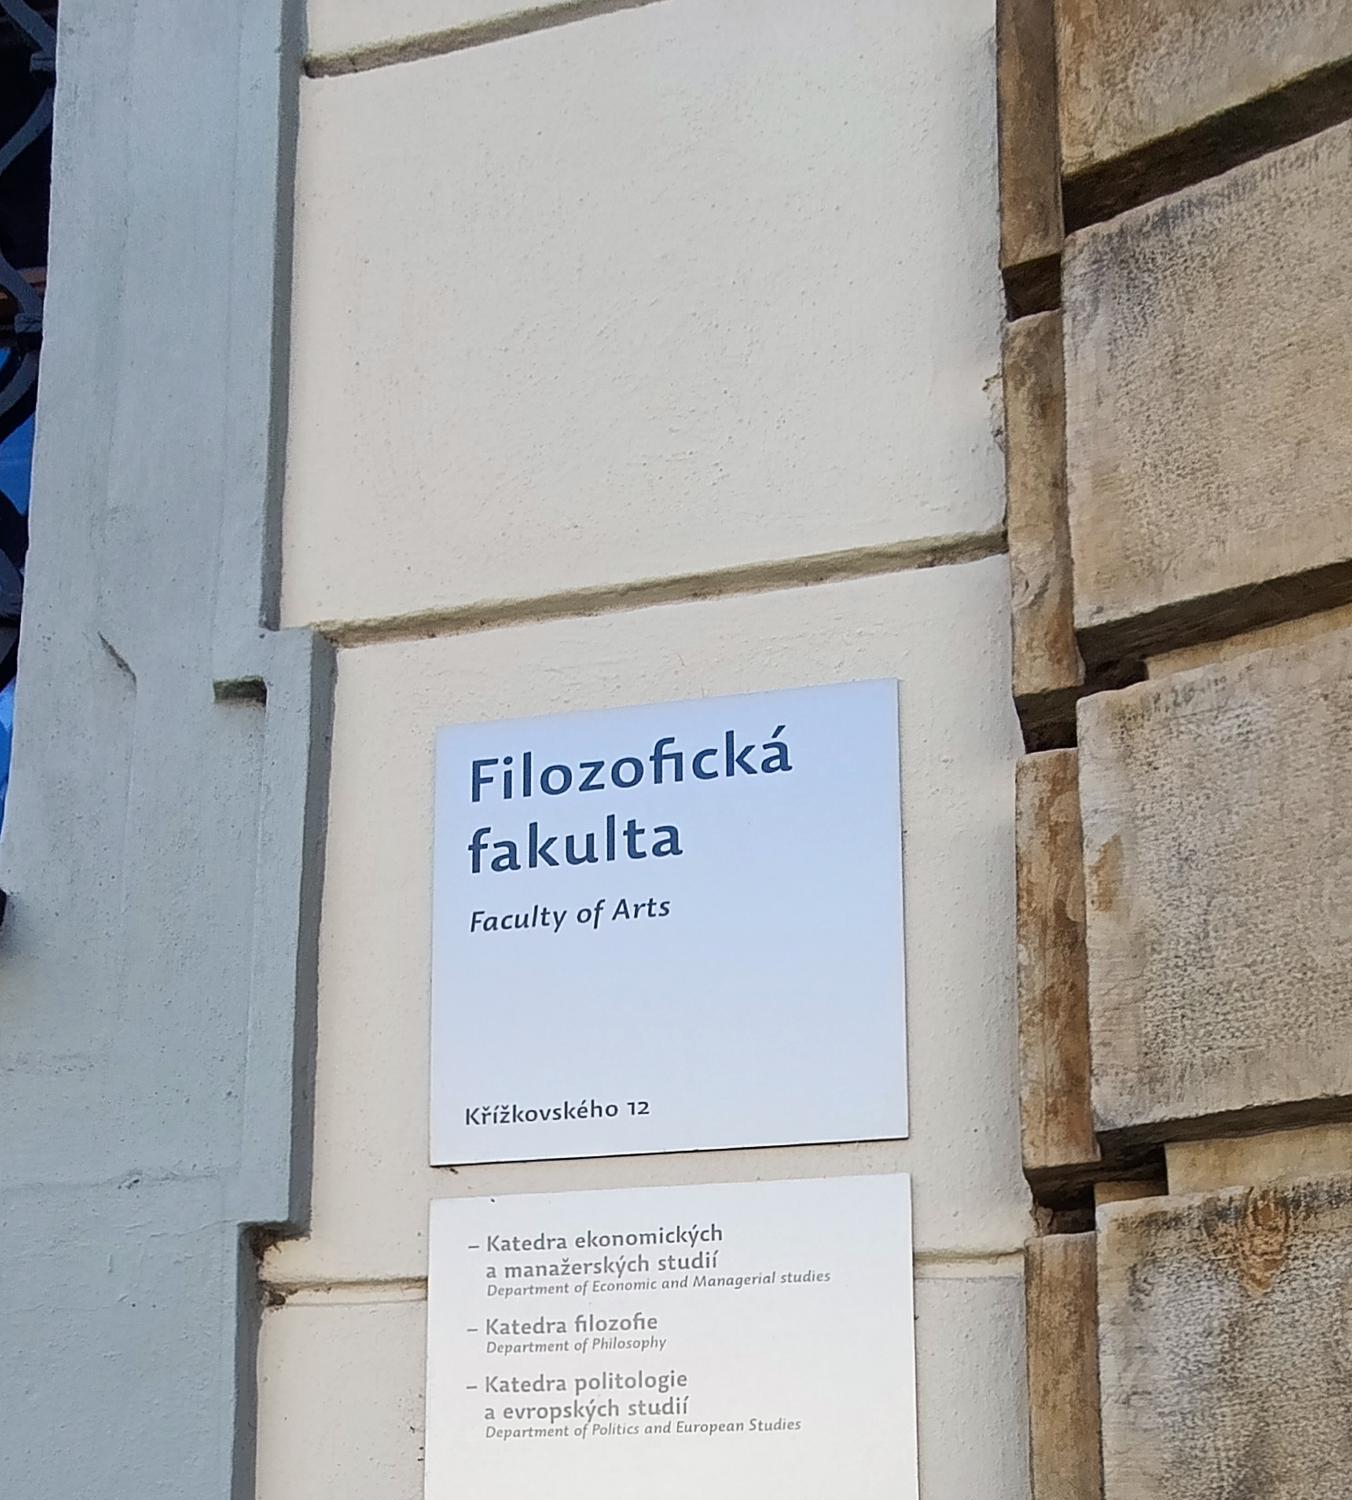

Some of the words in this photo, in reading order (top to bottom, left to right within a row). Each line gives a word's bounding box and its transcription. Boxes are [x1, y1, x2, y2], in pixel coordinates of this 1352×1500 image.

[471, 725, 793, 802] Filozofická
[468, 814, 683, 873] fakulta
[470, 904, 567, 932] Faculty
[576, 900, 605, 929] of
[611, 898, 670, 921] Arts
[465, 1100, 618, 1126] Křížkovského
[627, 1100, 650, 1116] 12
[487, 1233, 567, 1253] Katedra
[575, 1224, 723, 1249] ekonomických
[486, 1264, 496, 1279] a
[504, 1254, 649, 1279] manažerských
[658, 1250, 719, 1271] studií
[487, 1283, 569, 1299] Department
[574, 1280, 590, 1296] of
[592, 1278, 657, 1293] Economic
[661, 1275, 688, 1290] and
[692, 1271, 776, 1289] Managerial
[780, 1270, 831, 1284] studies
[485, 1316, 567, 1335] Katedra
[575, 1312, 658, 1333] filozofie
[486, 1340, 569, 1356] Department
[574, 1338, 591, 1353] of
[591, 1336, 667, 1352] Philosophy
[485, 1374, 567, 1393] Katedra
[575, 1370, 688, 1395] politologie
[484, 1406, 495, 1420] a
[503, 1399, 619, 1423] evropských
[628, 1396, 689, 1417] studií
[485, 1425, 569, 1441] Department
[574, 1423, 590, 1439] of
[592, 1421, 639, 1436] Politics
[644, 1420, 671, 1434] and
[676, 1419, 744, 1435] European
[749, 1417, 801, 1431] Studies
